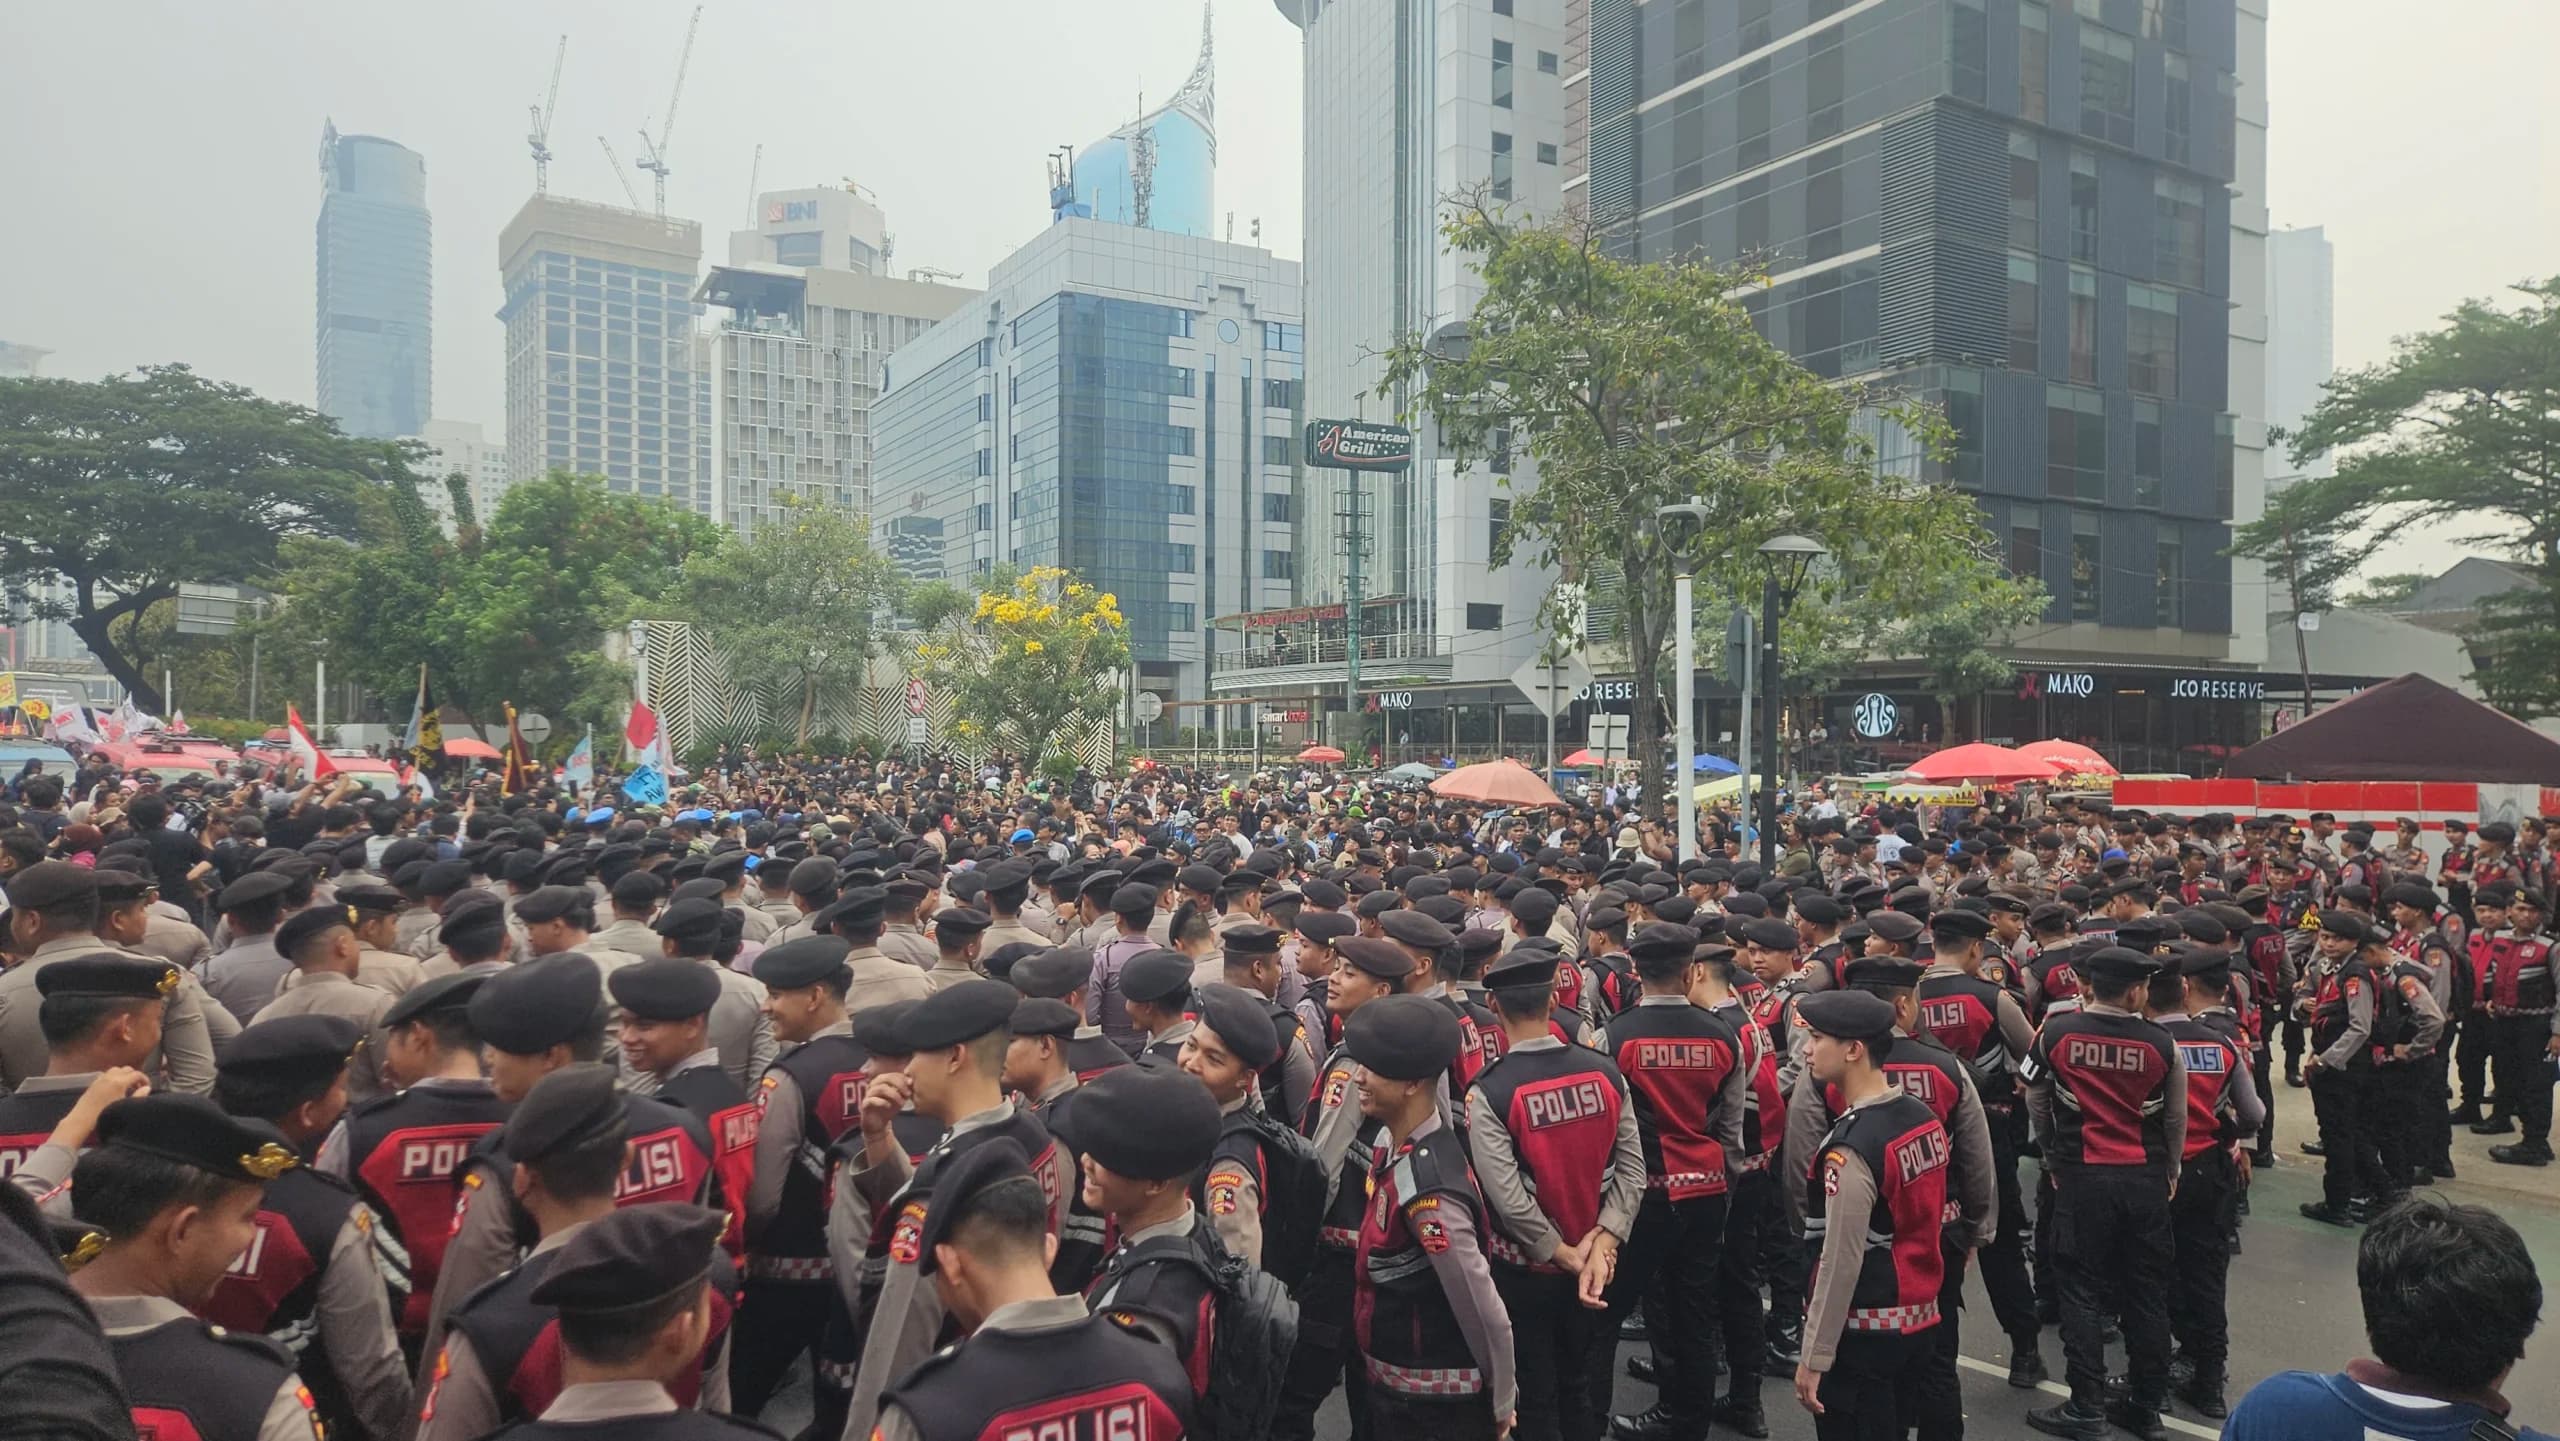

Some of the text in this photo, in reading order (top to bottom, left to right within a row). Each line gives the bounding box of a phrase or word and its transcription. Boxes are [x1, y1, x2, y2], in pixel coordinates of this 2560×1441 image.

[1341, 425, 1410, 443] American
[1340, 440, 1375, 456] Grill
[2047, 673, 2094, 698] MAKO
[2202, 680, 2265, 699] RESERVE
[1380, 692, 1412, 710] MAKO
[1640, 1045, 1714, 1068] POLISI
[2069, 1041, 2145, 1073] POLISI
[1526, 1081, 1606, 1127] POLISI
